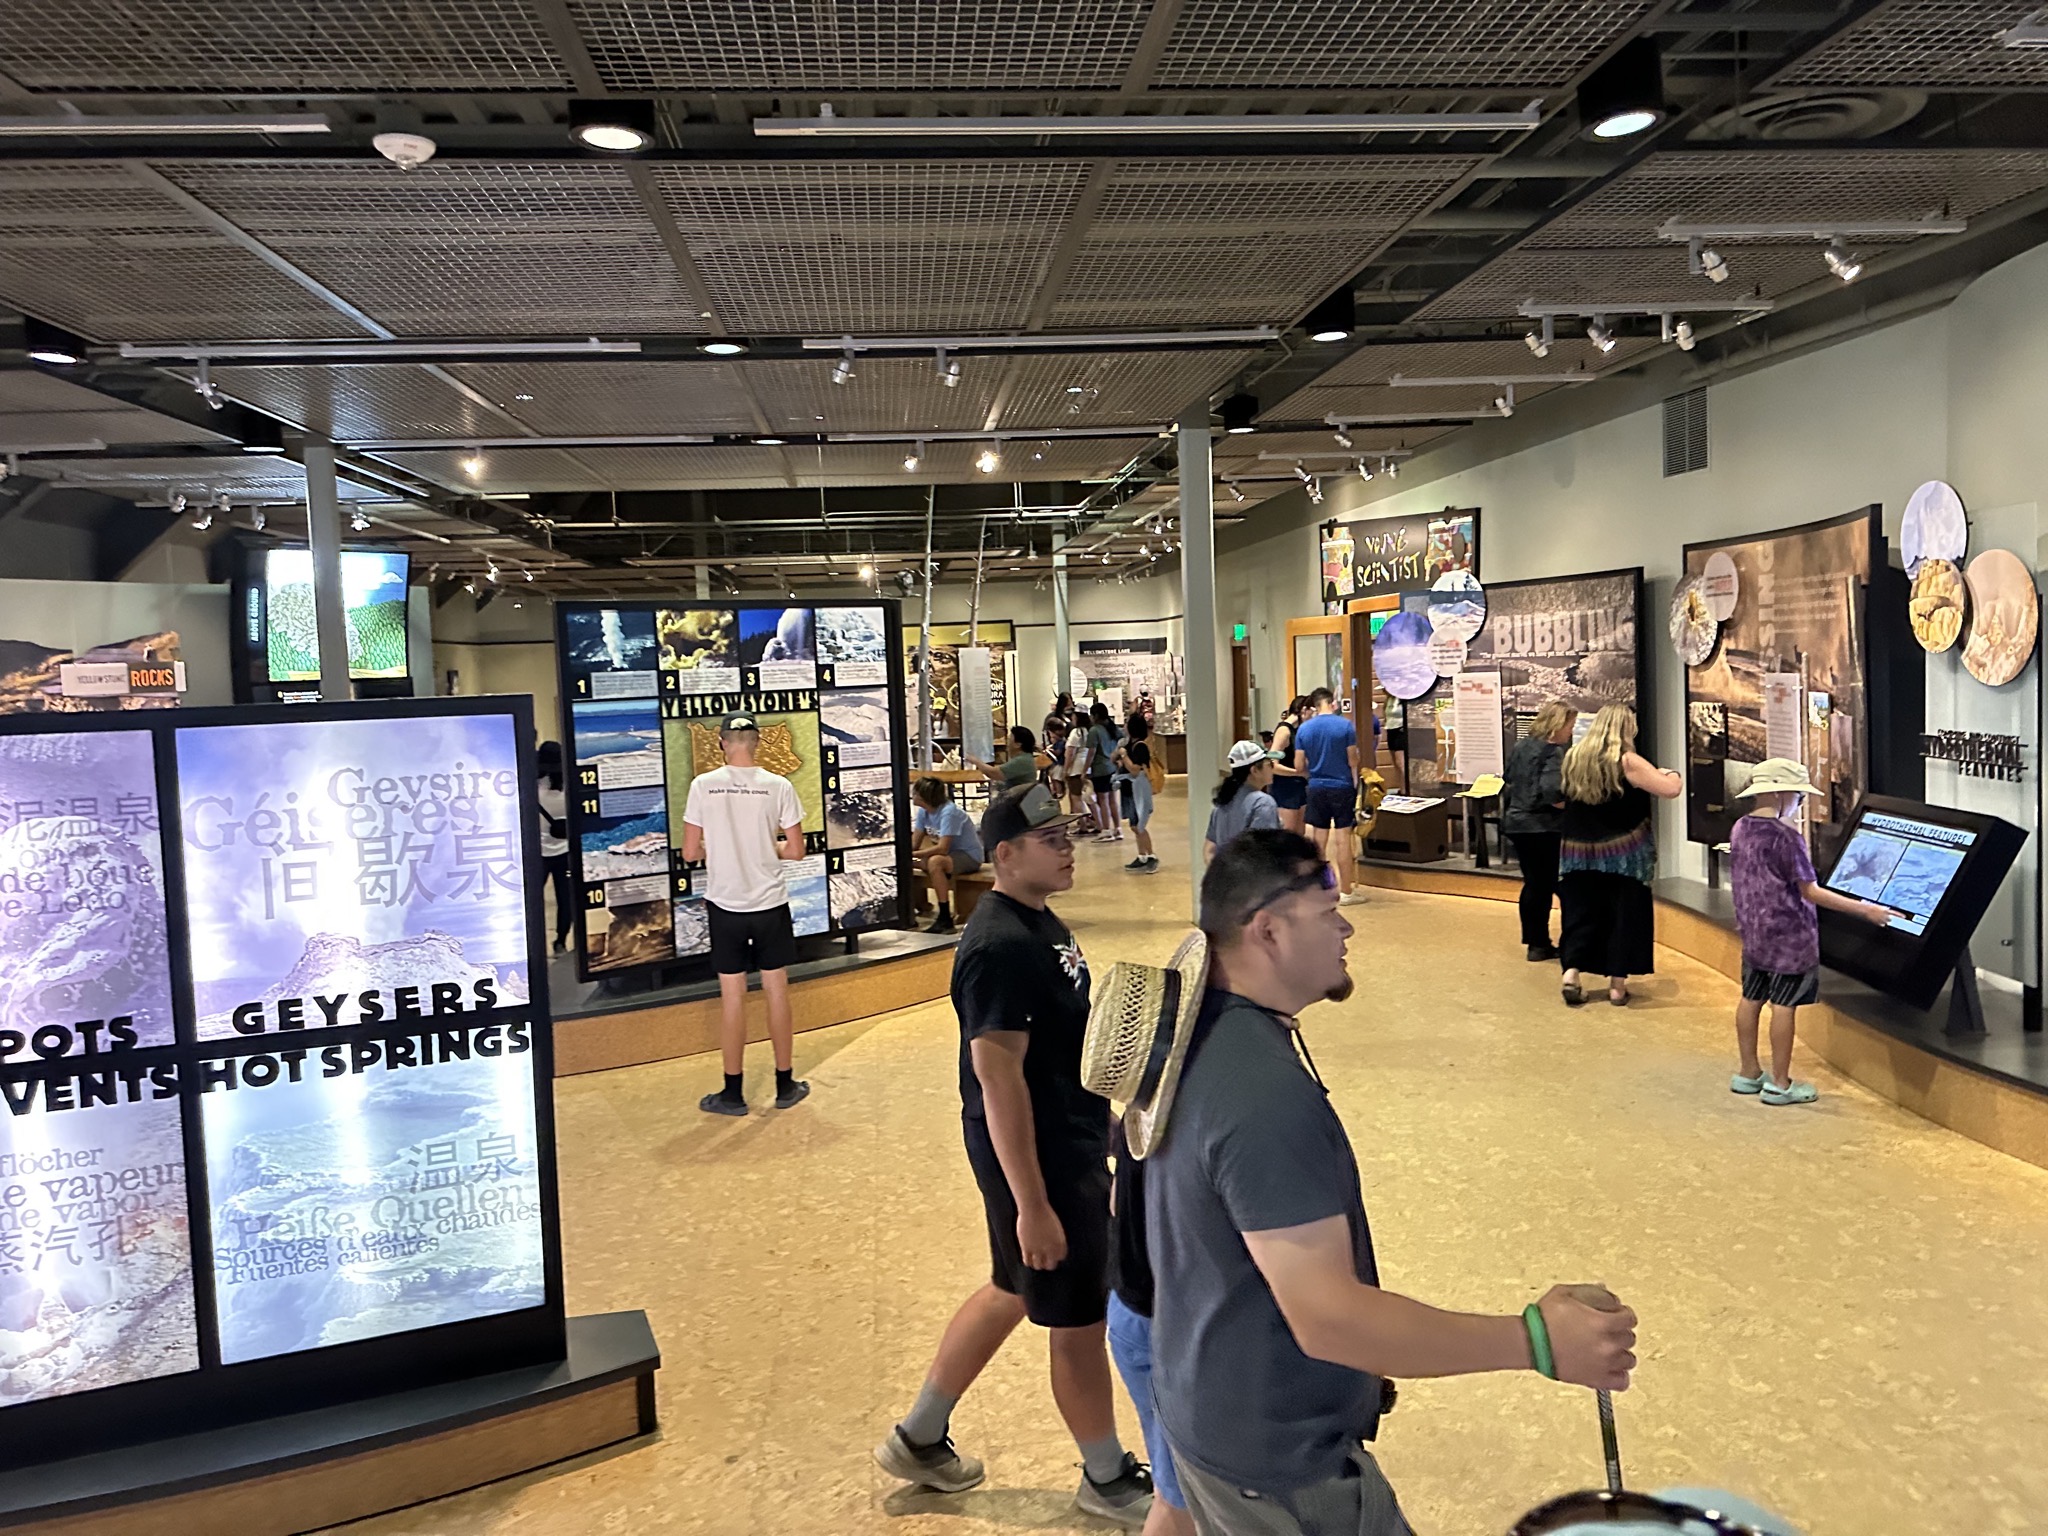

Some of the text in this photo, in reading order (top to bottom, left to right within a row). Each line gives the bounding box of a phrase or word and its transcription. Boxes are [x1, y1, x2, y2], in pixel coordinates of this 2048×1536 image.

[1365, 525, 1409, 555] YOUNG
[1357, 552, 1421, 587] SCIENTIST
[1493, 608, 1635, 654] BUBBLING
[130, 668, 174, 687] ROCKS
[577, 679, 586, 693] 1
[665, 676, 675, 690] 2
[747, 672, 756, 686] 3
[823, 669, 831, 682] 4
[827, 751, 836, 764] 5
[580, 771, 596, 785] 12
[828, 777, 837, 789] 6
[582, 800, 598, 813] 11
[1871, 817, 1968, 845] HYDROTHERMAL FEATURES
[832, 857, 840, 870] 7
[587, 889, 604, 904] 10
[678, 878, 687, 891] 9
[232, 978, 498, 1034] GEYSERS
[201, 1022, 531, 1093] HOT SPRINGS
[0, 1063, 179, 1116] VENTS
[408, 1132, 523, 1194] 温泉
[40, 1162, 184, 1204] vapeur
[52, 1191, 157, 1223] vapor
[230, 1182, 525, 1252] Heiße Quellen
[215, 1238, 328, 1270] Sources
[436, 1202, 542, 1235] chaudes
[227, 1237, 440, 1285] Fuentes calientes
